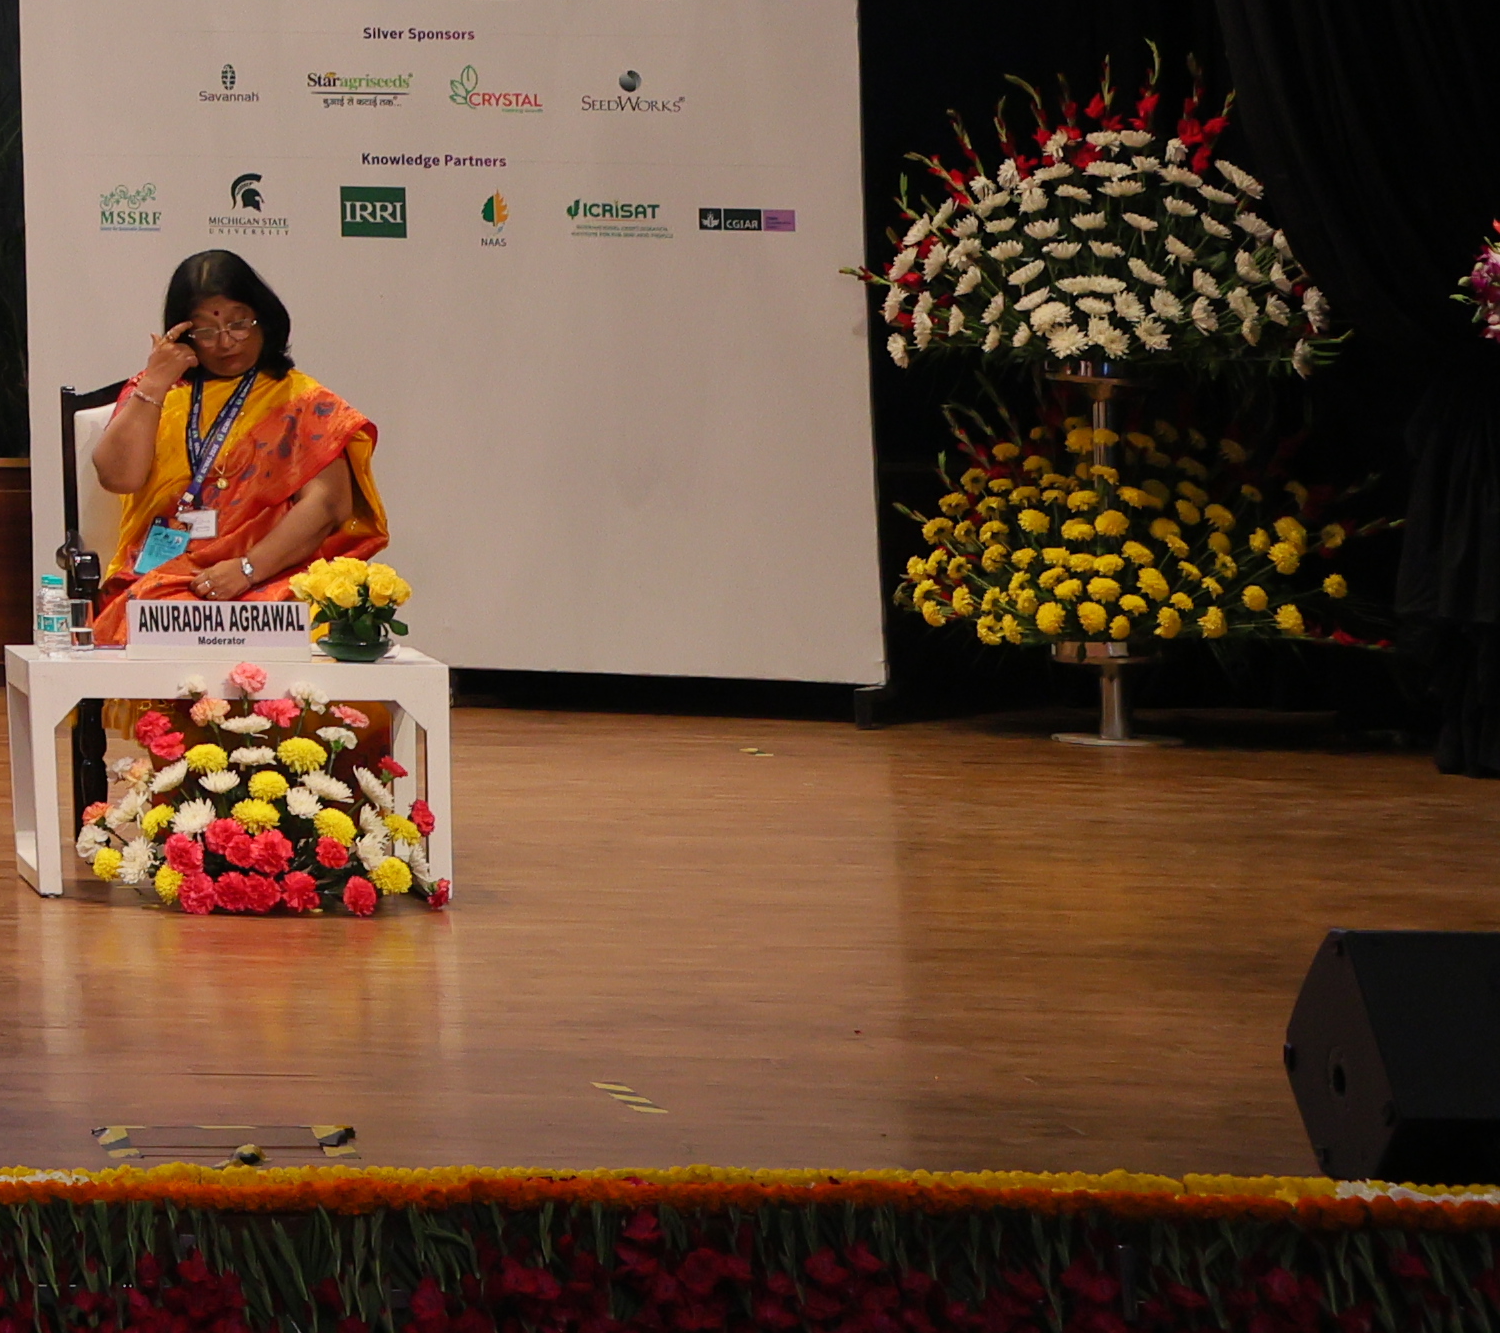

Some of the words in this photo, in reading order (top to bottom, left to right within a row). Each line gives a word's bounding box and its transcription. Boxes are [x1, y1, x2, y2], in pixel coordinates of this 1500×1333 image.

[363, 26, 405, 40] Silver
[408, 27, 475, 43] Sponsors
[198, 90, 260, 103] Savannah
[469, 93, 543, 107] CRYSTAL
[361, 152, 441, 169] Knowledge
[444, 154, 507, 168] Partners
[344, 201, 403, 223] IRRI
[583, 201, 660, 219] ICRISAT
[100, 211, 162, 225] MSSRF
[209, 216, 258, 226] MICHIGAN
[262, 217, 289, 227] STATE
[726, 219, 758, 229] CGIAR
[209, 227, 290, 235] UNIVERSITY
[480, 237, 507, 248] NAAS
[139, 605, 225, 633] ANURADHA
[229, 604, 305, 632] AGRAWAL
[198, 636, 245, 646] Moderator
